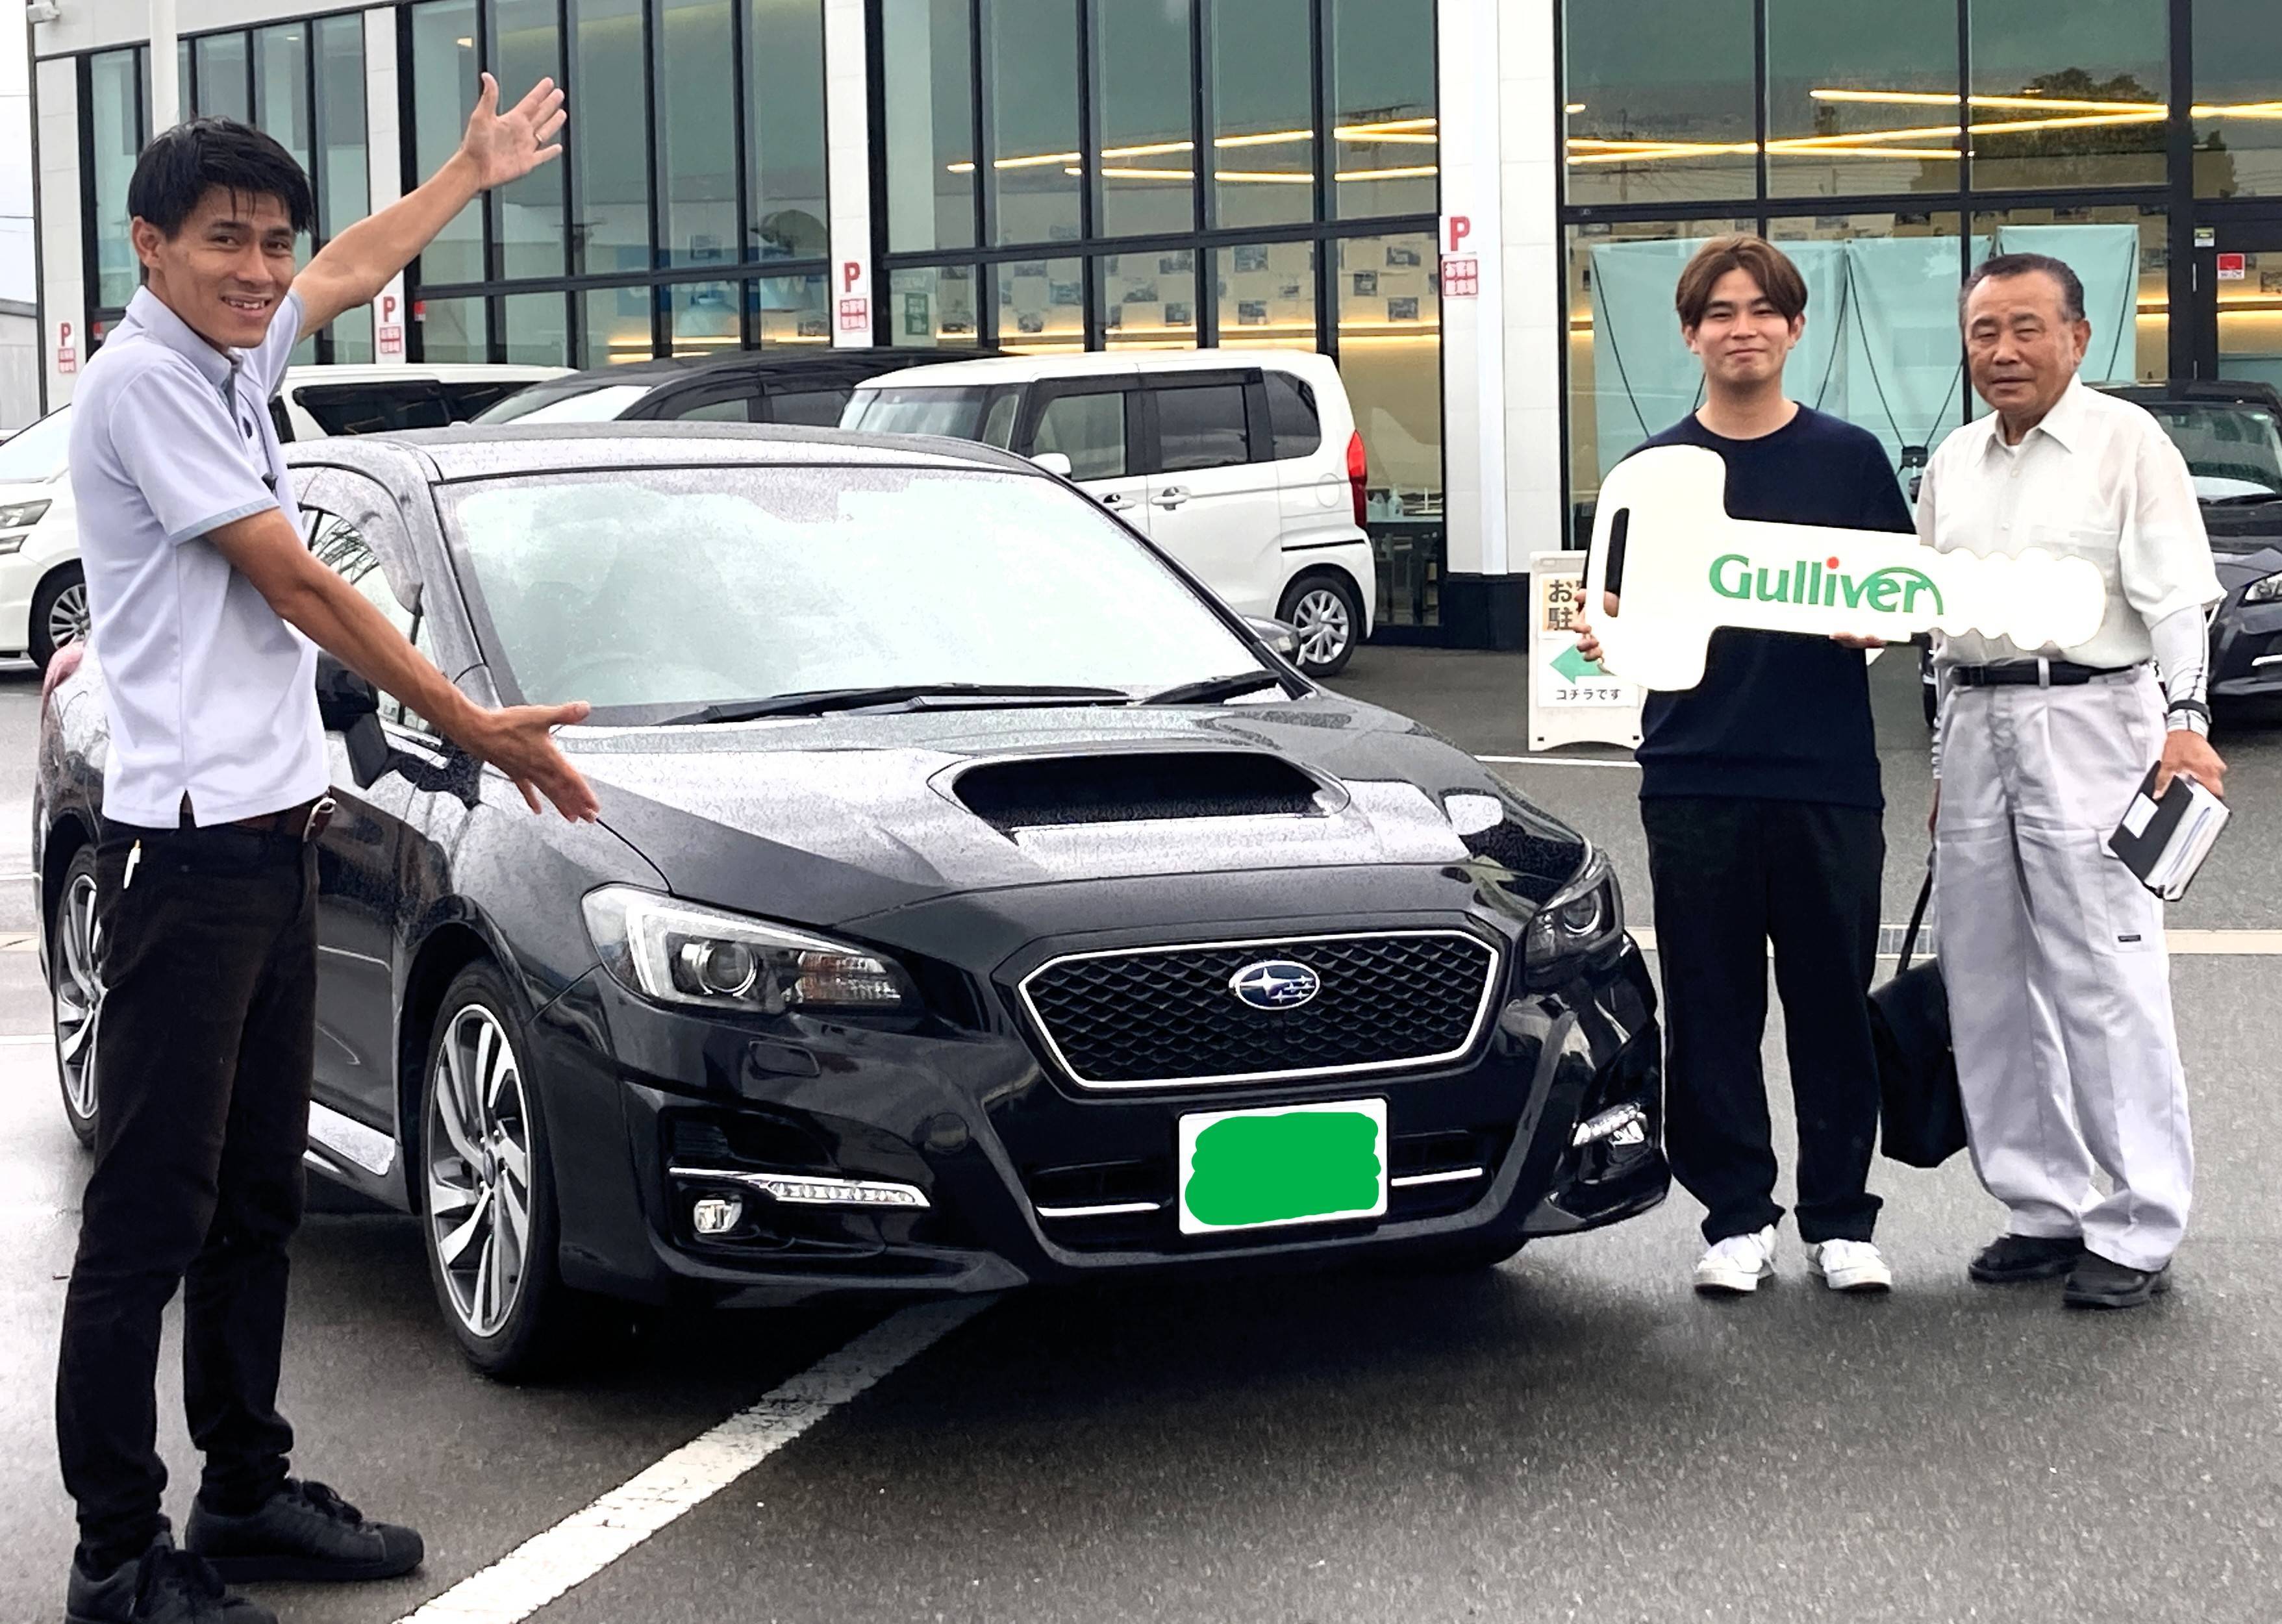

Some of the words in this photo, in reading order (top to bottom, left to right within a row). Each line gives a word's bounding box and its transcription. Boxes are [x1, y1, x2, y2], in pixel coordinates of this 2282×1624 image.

[1451, 216, 1470, 251] P
[844, 262, 860, 292] P
[383, 296, 395, 322] P
[60, 322, 71, 346] P
[1549, 579, 1583, 603] お
[1709, 554, 1944, 615] Gulliver
[1556, 688, 1622, 700] コチラです
